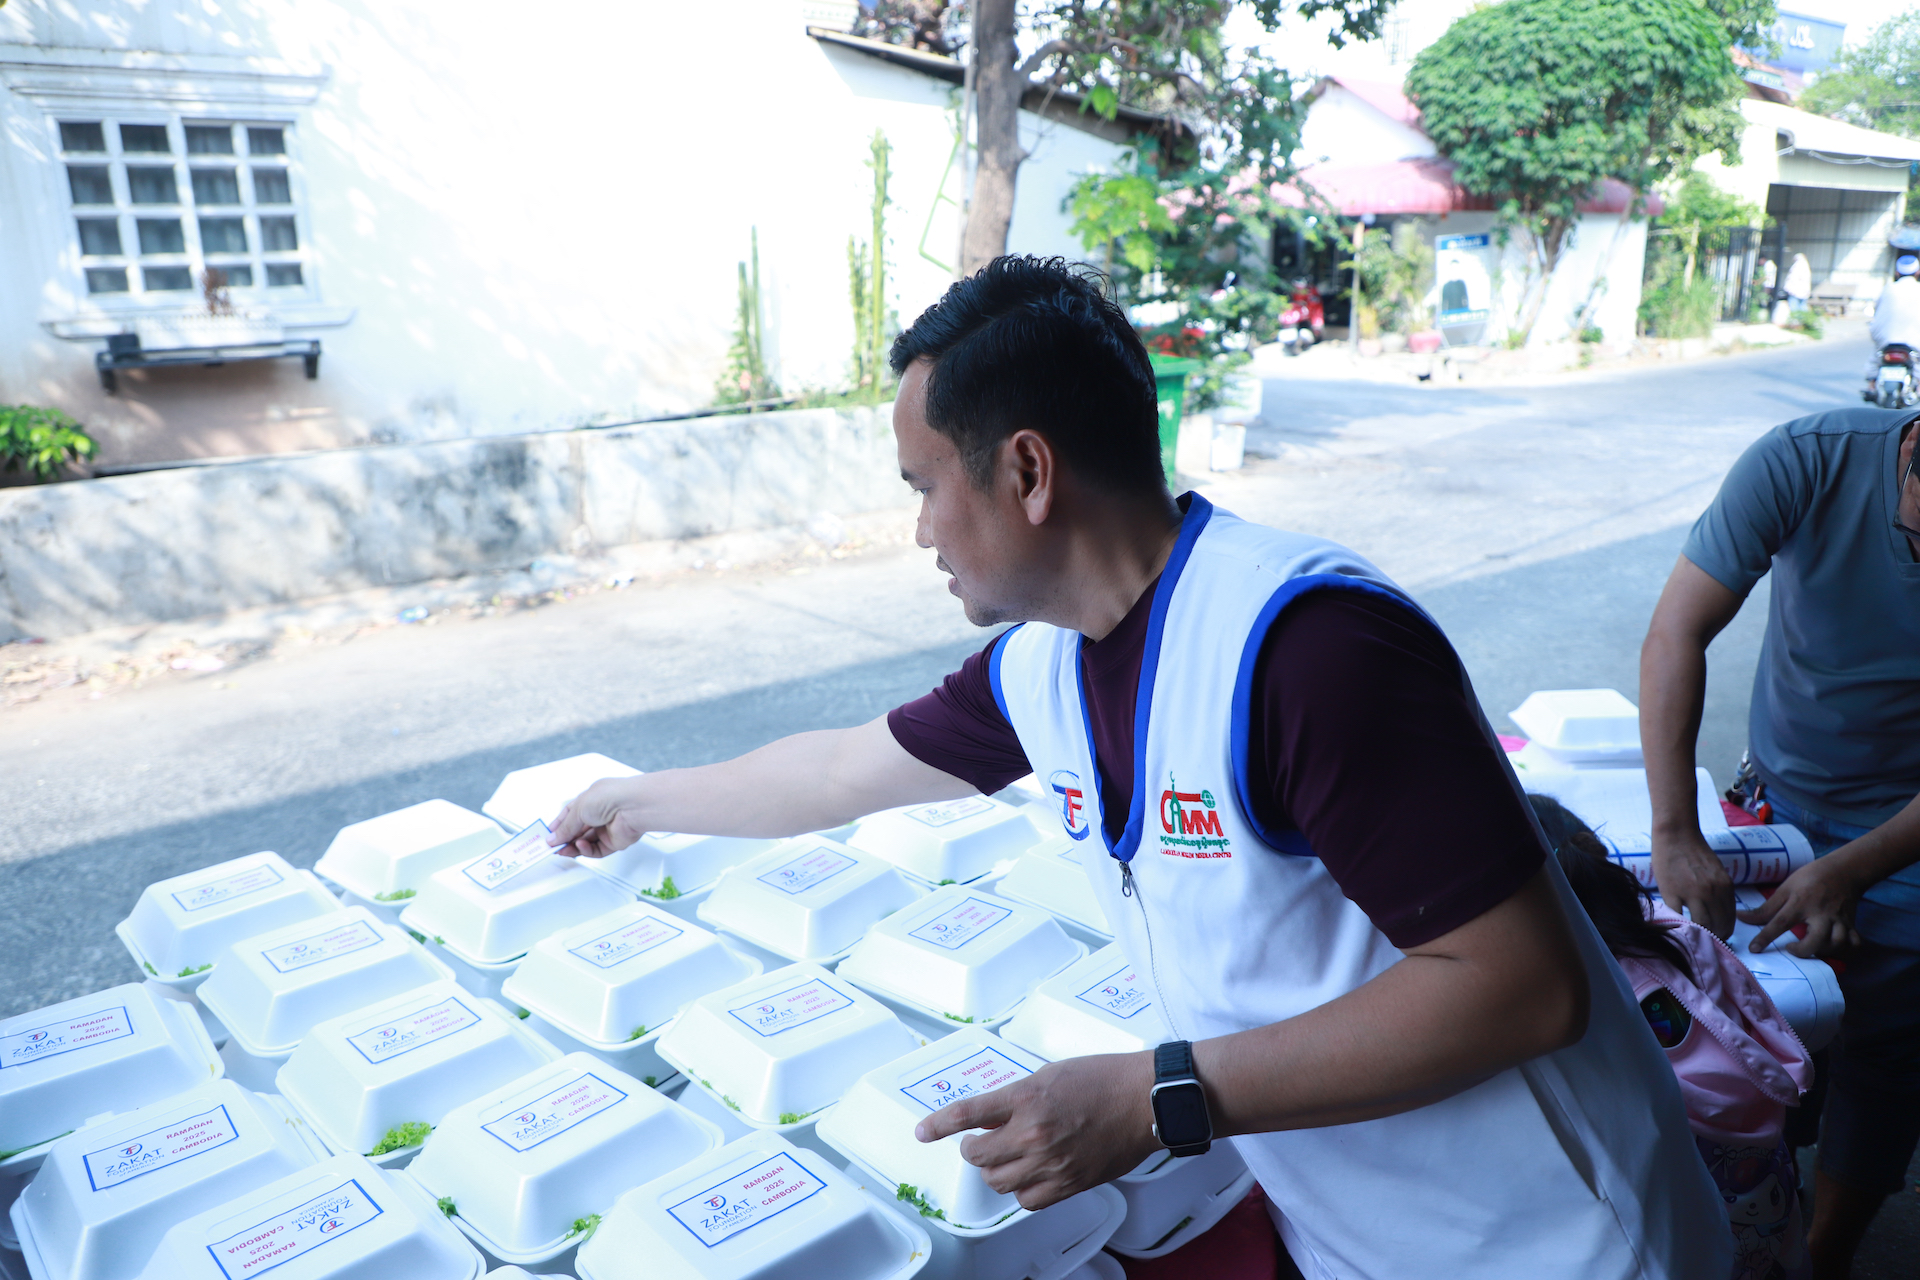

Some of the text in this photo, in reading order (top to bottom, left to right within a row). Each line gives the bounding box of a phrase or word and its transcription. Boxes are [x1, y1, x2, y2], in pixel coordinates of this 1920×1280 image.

[70, 1015, 113, 1030] RAMADAN
[756, 1008, 795, 1025] ZAKAT
[72, 1027, 120, 1043] CAMBODIA
[84, 1025, 106, 1034] 2025
[12, 1036, 65, 1055] ZAKAT
[371, 1031, 416, 1052] ZAKAT
[961, 1059, 994, 1077] RAMADAN
[980, 1068, 998, 1080] 2025
[982, 1070, 1018, 1090] CAMBODIA
[551, 1084, 590, 1106] RAMADAN
[568, 1094, 610, 1117] CAMBODIA
[570, 1094, 590, 1106] 2025
[933, 1083, 974, 1107] ZAKAT
[166, 1119, 213, 1140] RAMADAN
[182, 1130, 206, 1143] 2025
[512, 1112, 560, 1139] ZAKAT
[172, 1132, 223, 1154] CAMBODIA
[105, 1147, 162, 1174] ZAKAT
[107, 1154, 165, 1178] FOUNDATION
[743, 1166, 785, 1190] RAMADAN
[763, 1179, 785, 1193] 2025
[761, 1180, 806, 1206] CAMBODIA
[291, 1195, 349, 1226] FOUNDATION
[297, 1199, 354, 1232] ZAKAT
[700, 1198, 752, 1229] ZAKAT
[708, 1205, 758, 1233] FOUNDATION
[228, 1225, 285, 1254] CAMBODIA
[249, 1240, 275, 1256] 2025
[242, 1241, 297, 1269] RAMADAN
